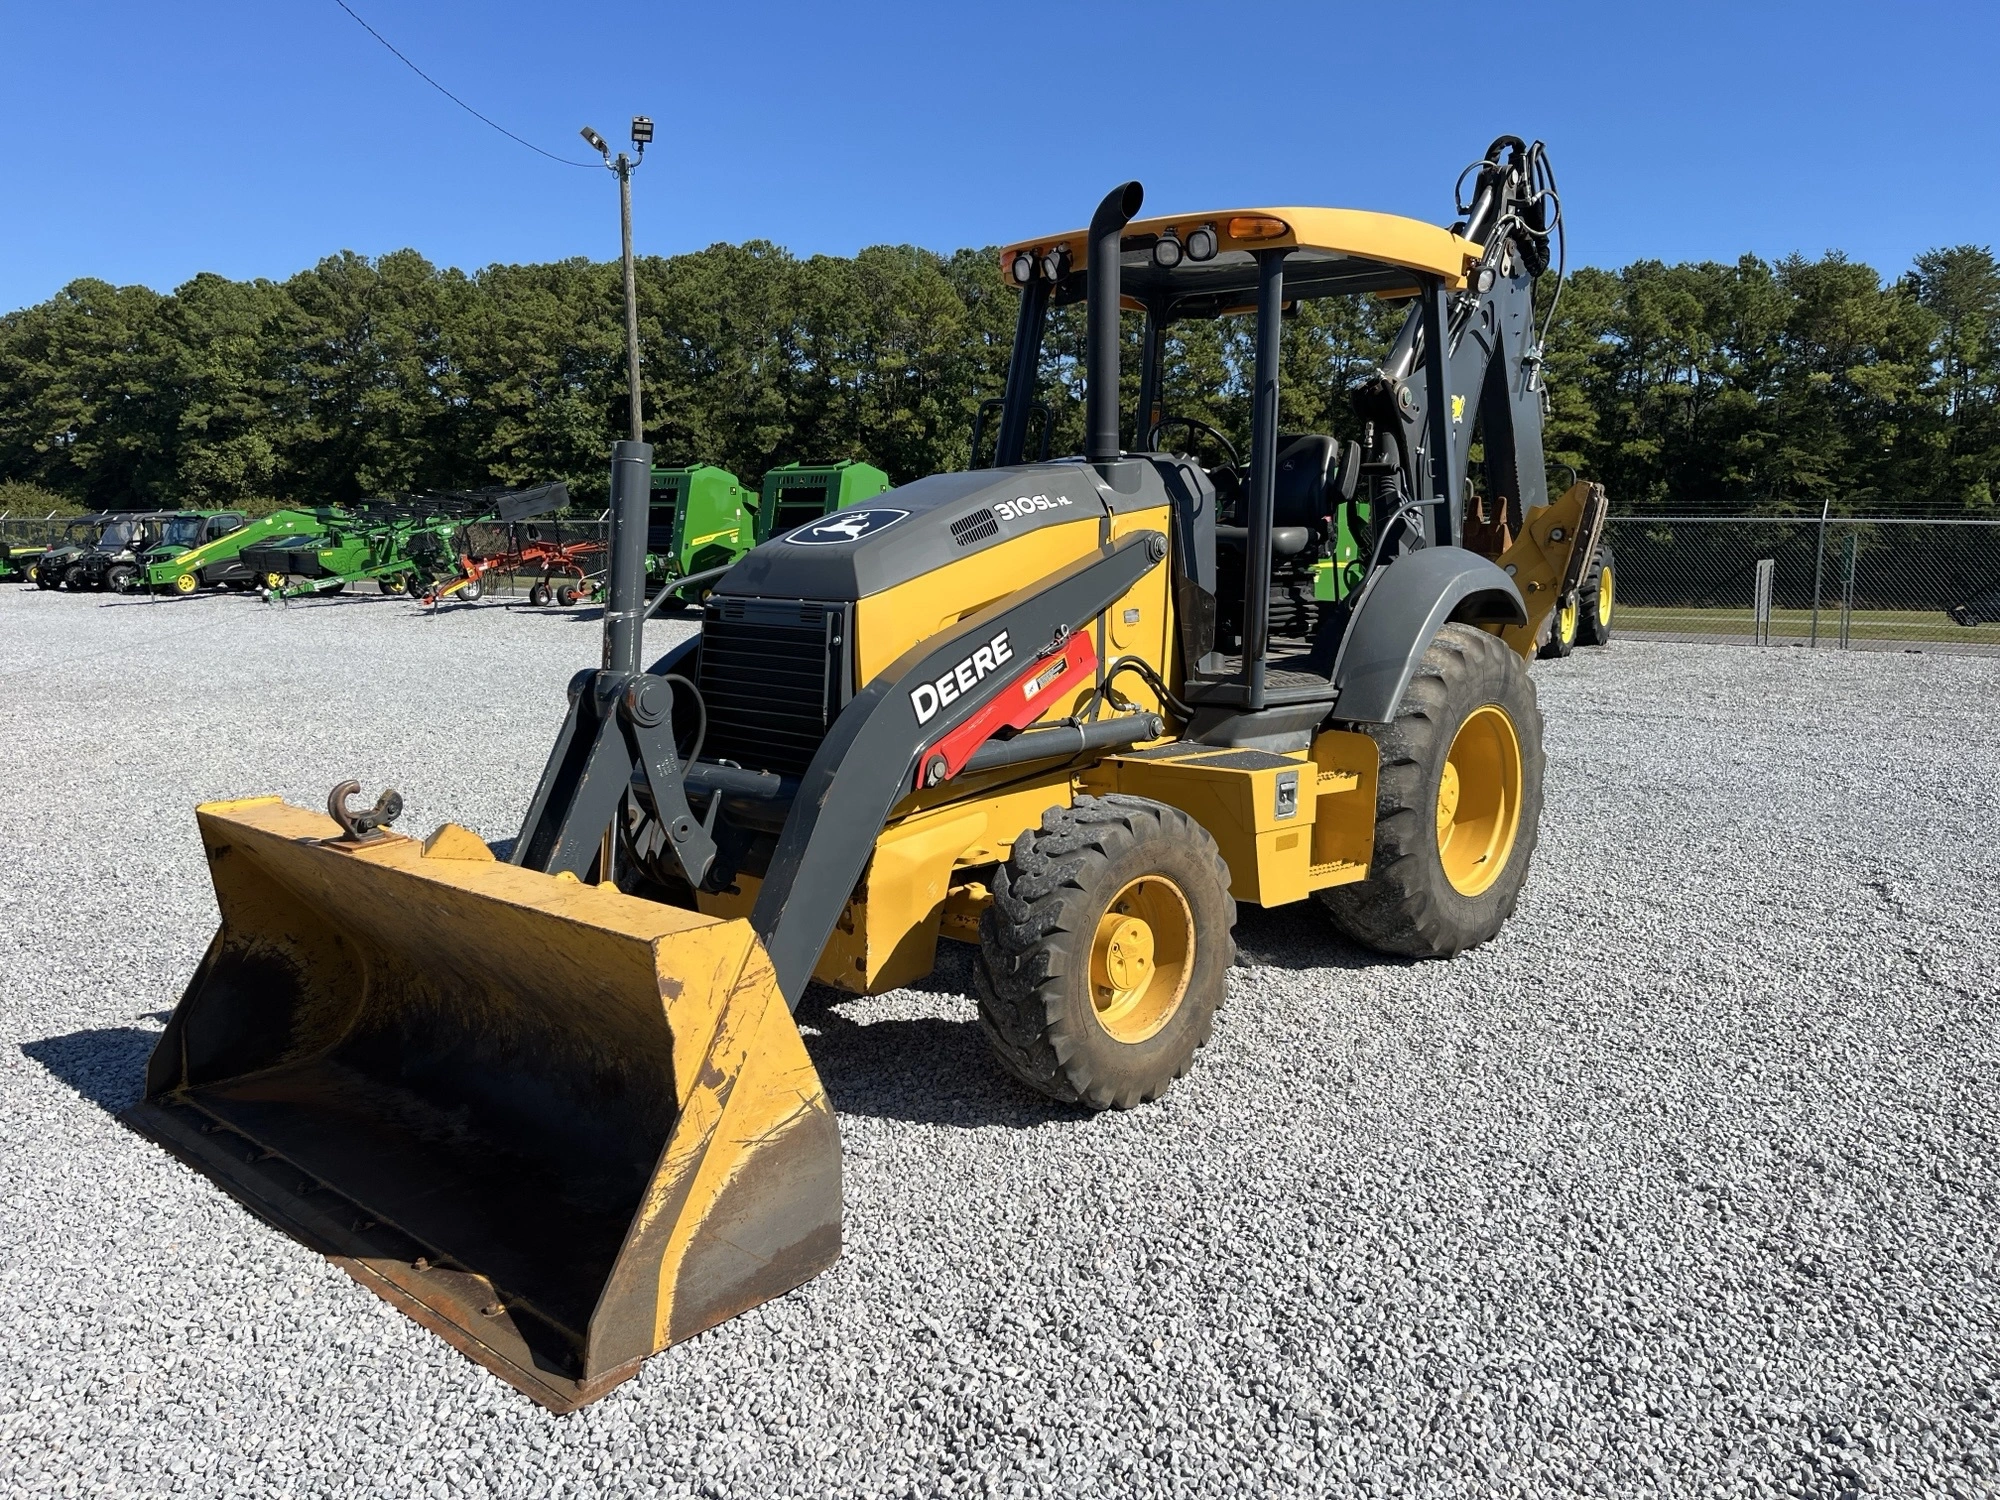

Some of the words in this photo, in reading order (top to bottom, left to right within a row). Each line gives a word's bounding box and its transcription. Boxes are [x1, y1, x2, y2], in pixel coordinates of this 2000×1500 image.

[993, 494, 1059, 521] 310SL
[1056, 495, 1073, 506] HL
[909, 629, 1014, 726] DEERE
